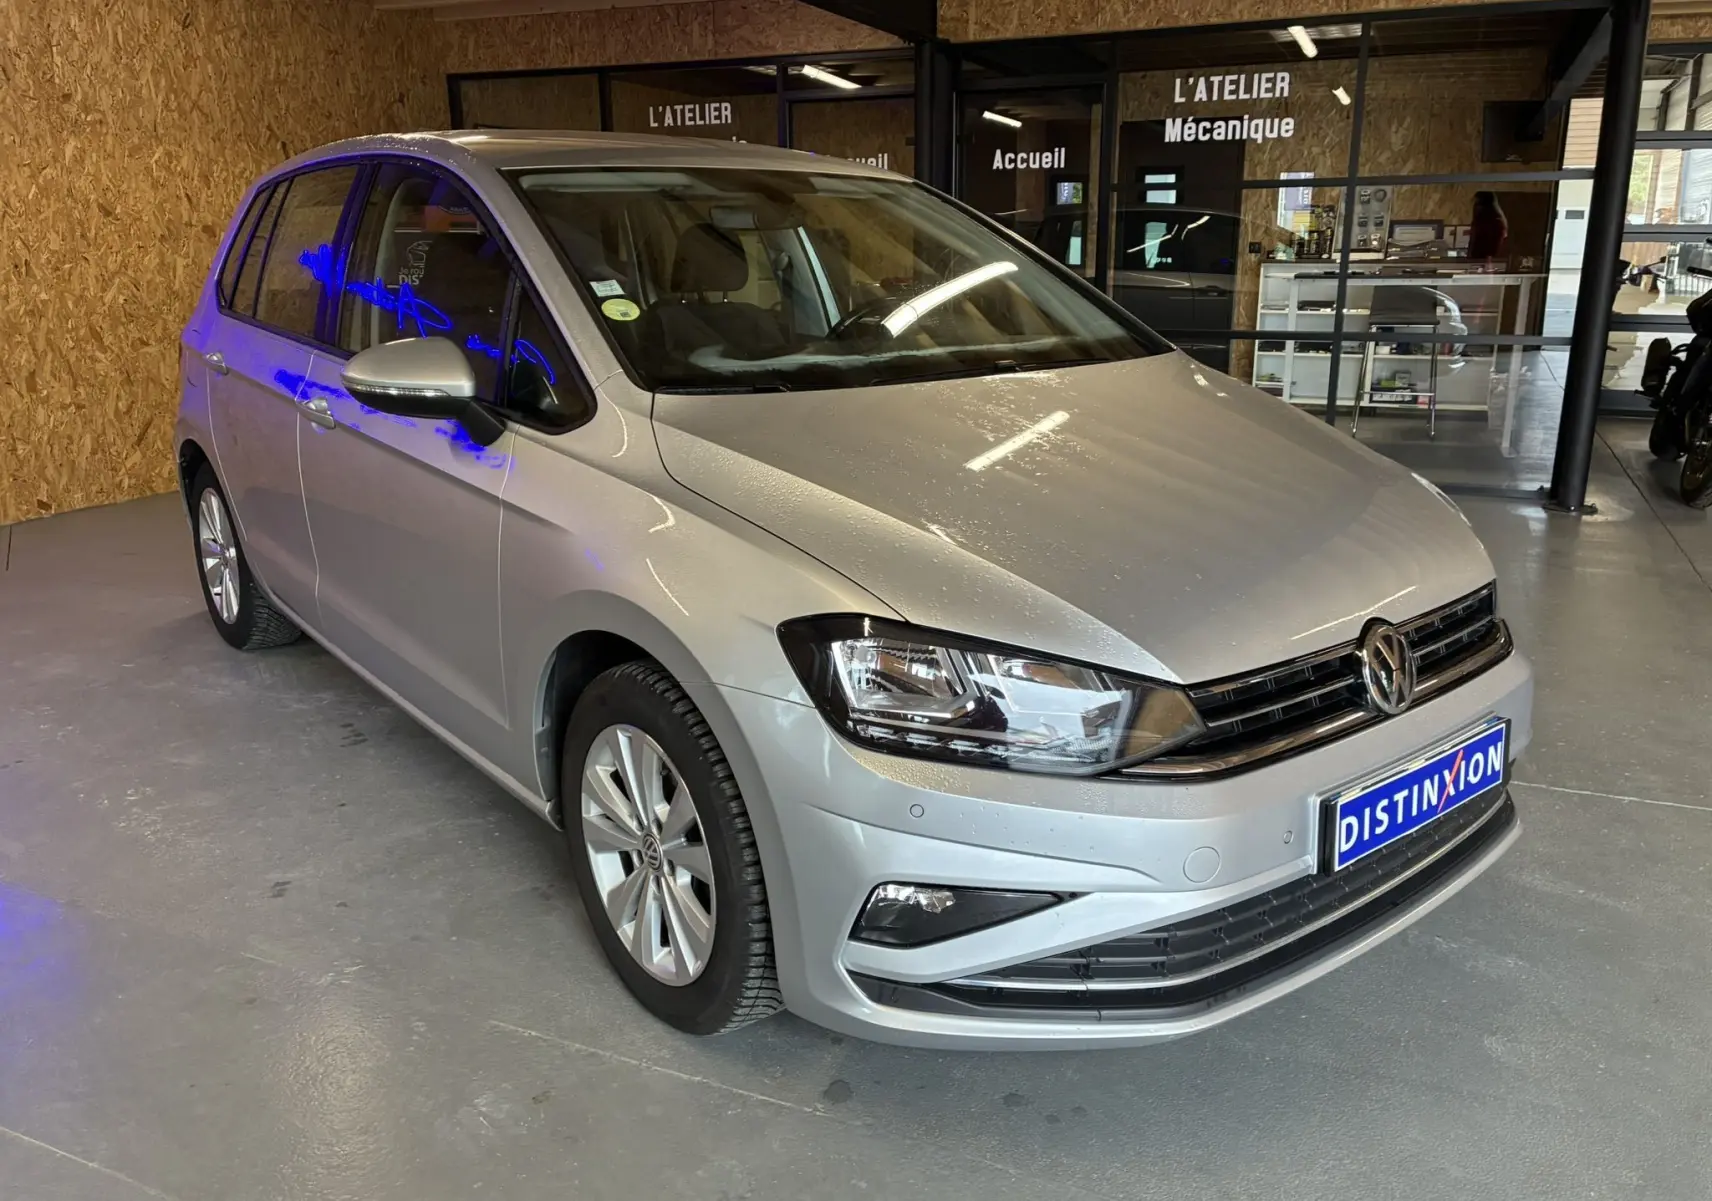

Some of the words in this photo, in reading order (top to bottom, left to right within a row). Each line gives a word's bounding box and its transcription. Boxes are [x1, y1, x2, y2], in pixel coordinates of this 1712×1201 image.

[1173, 72, 1290, 103] L'ATELIER
[649, 102, 732, 127] L'ATELIER
[1164, 115, 1295, 143] Mécanique
[992, 147, 1066, 170] Accueil
[1340, 742, 1502, 853] DISTINXION
